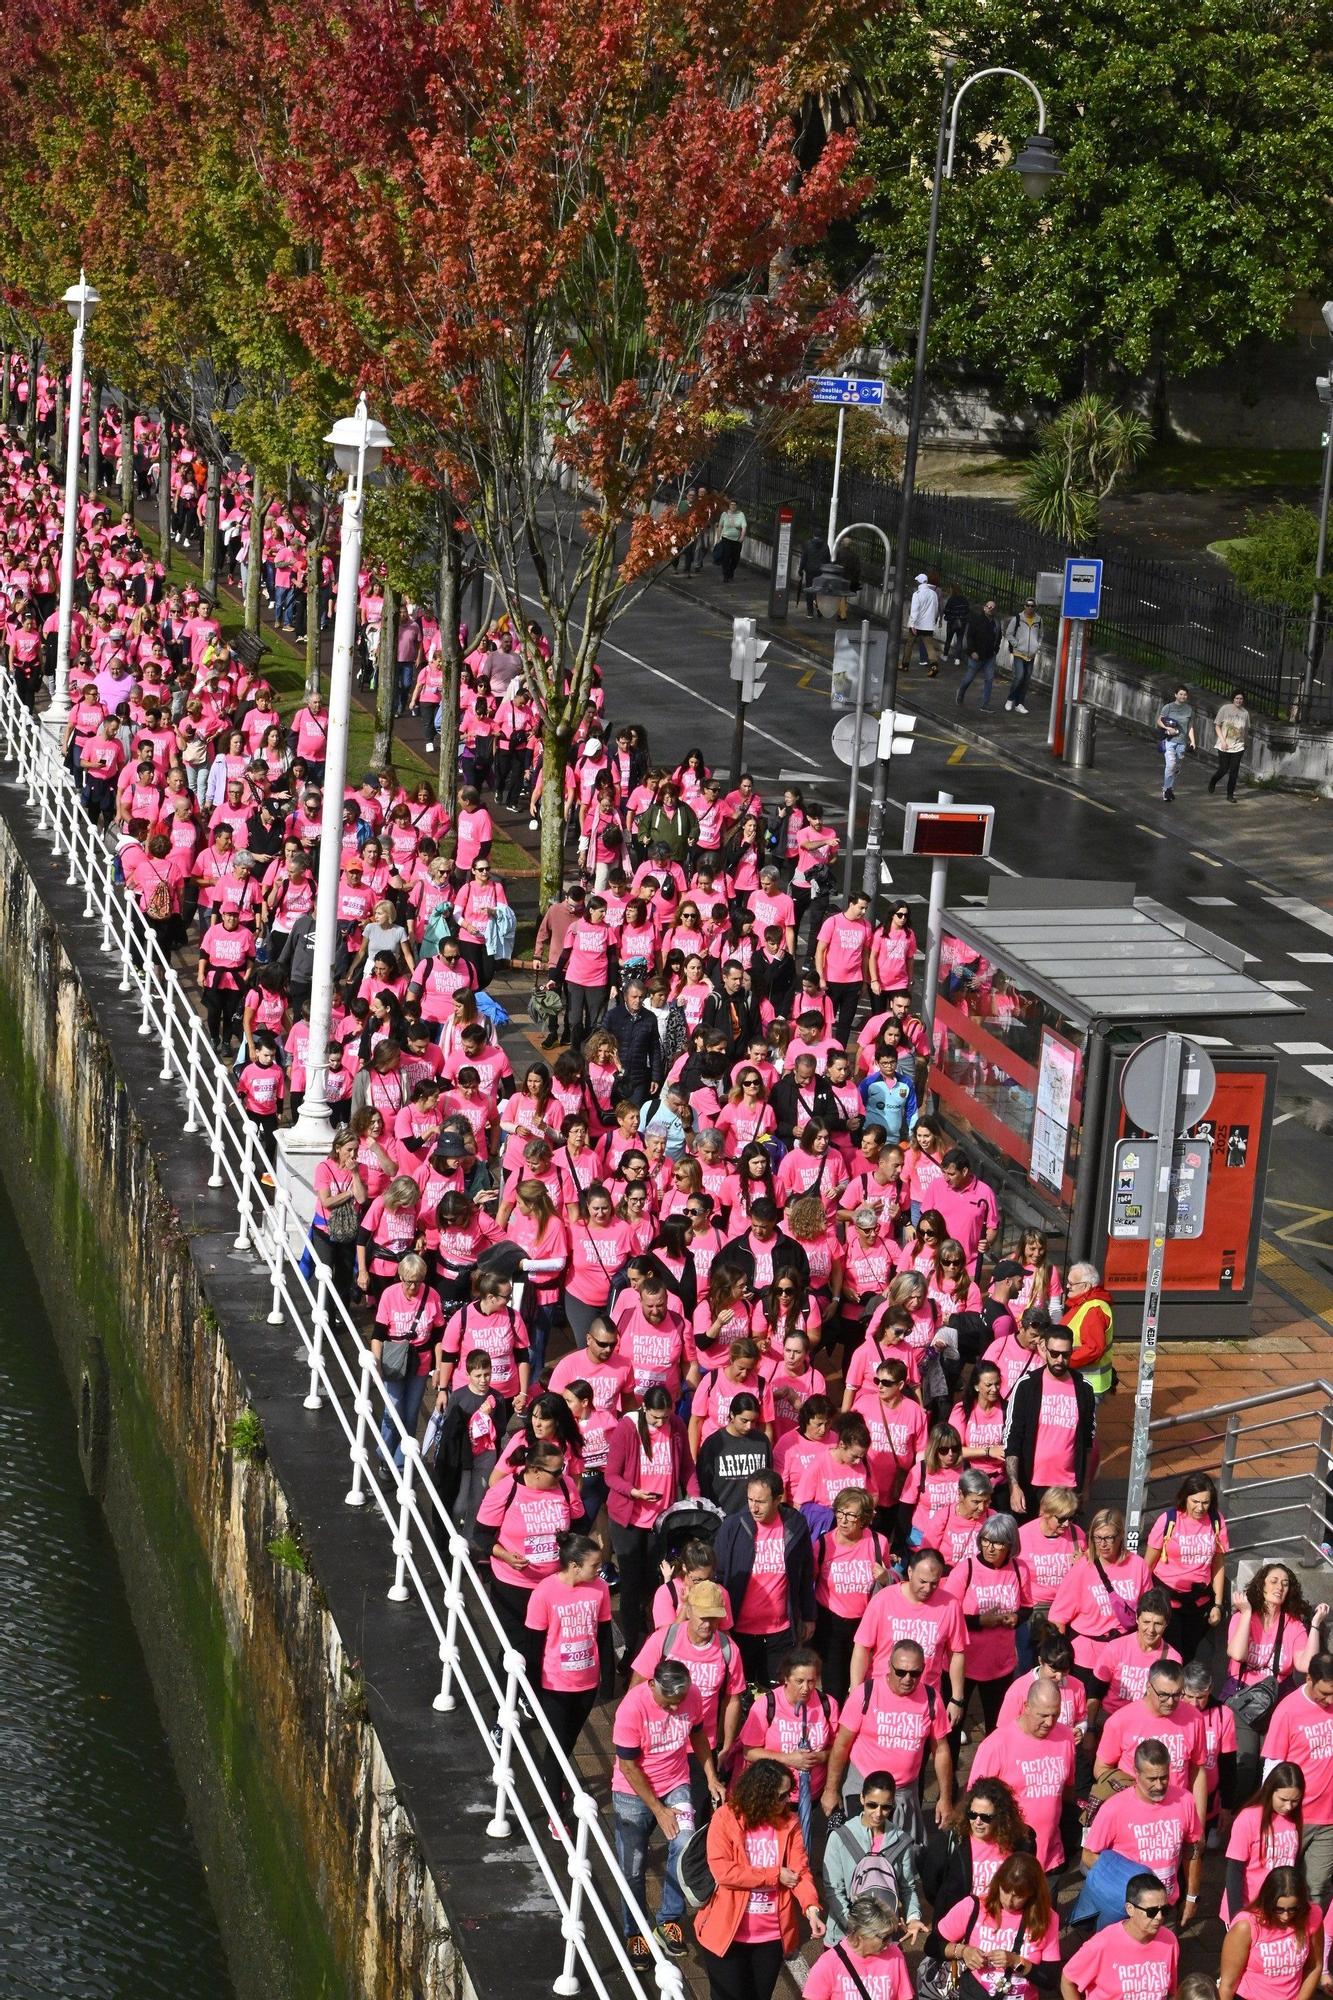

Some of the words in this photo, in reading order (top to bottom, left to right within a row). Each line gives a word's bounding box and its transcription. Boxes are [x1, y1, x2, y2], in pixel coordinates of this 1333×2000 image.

[1216, 1125, 1227, 1154] 2025
[532, 1545, 554, 1553] 2025
[568, 1652, 589, 1661] 2025
[750, 1892, 769, 1901] 025
